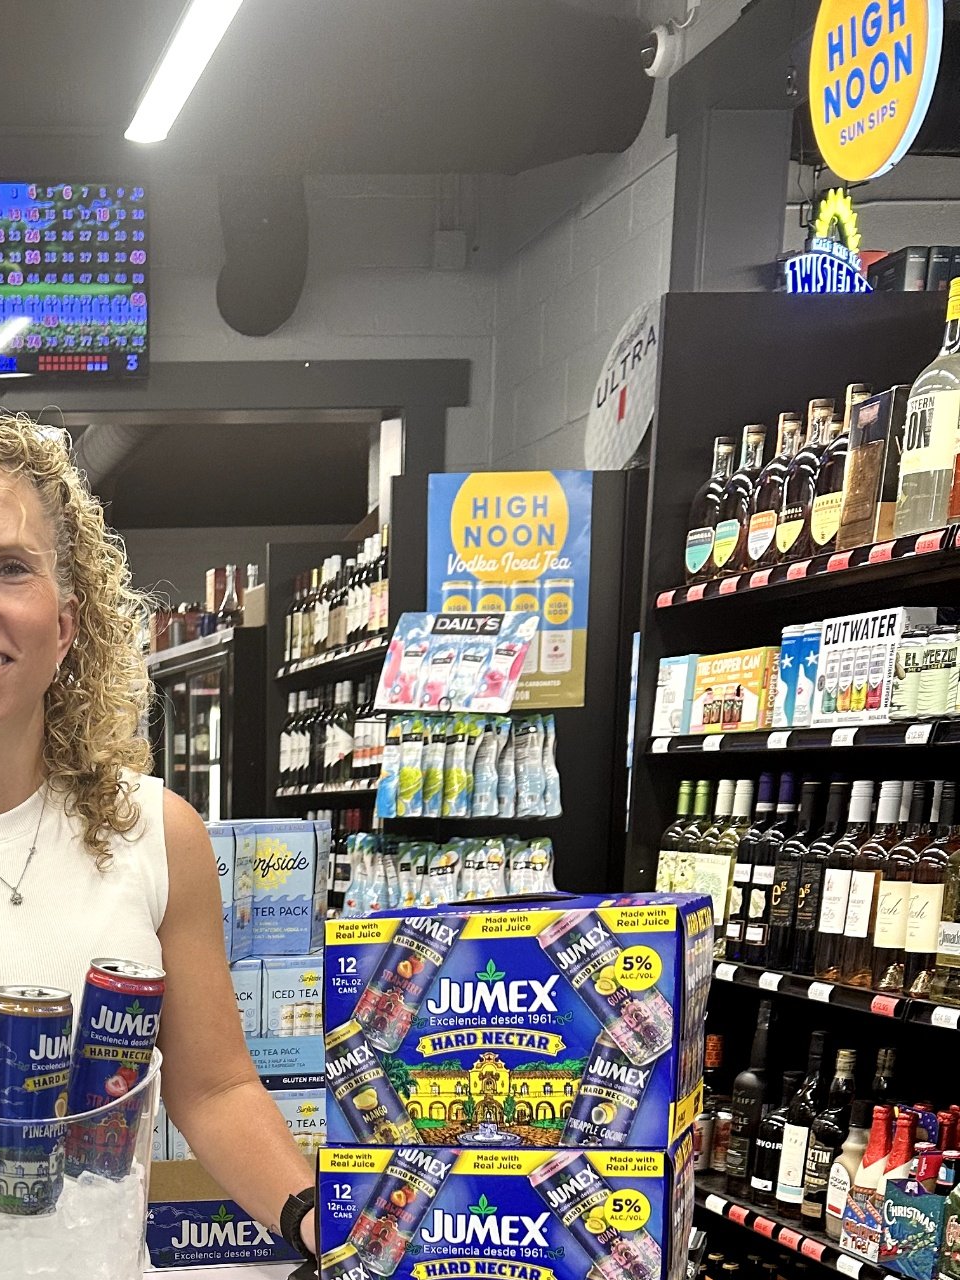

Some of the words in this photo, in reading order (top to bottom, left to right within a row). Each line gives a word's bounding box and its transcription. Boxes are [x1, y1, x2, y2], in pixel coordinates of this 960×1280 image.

[828, 0, 906, 71] HIGH
[824, 34, 913, 124] NOON
[840, 118, 864, 145] SUN
[868, 105, 896, 130] SIPS
[597, 326, 656, 409] ULTRA
[472, 496, 548, 519] HIGH
[464, 524, 555, 547] NOON
[447, 553, 498, 575] Vodka
[500, 552, 540, 572] Iced
[542, 550, 572, 571] Tea
[436, 615, 500, 632] DAILY'S
[824, 614, 896, 645] CUTWATER
[698, 663, 711, 675] THE
[712, 657, 741, 673] COPPER
[743, 653, 763, 670] CAN
[905, 653, 919, 666] EL
[280, 907, 308, 916] PACK
[621, 911, 642, 919] Made
[645, 910, 666, 918] with
[338, 923, 360, 931] Made
[617, 919, 640, 927] Real
[642, 917, 669, 926] Juice
[336, 931, 354, 939] Real
[357, 929, 380, 938] Juice
[338, 957, 356, 973] 12
[622, 955, 652, 971] 5%
[427, 975, 560, 1014] JUMEX
[429, 1015, 487, 1026] Excelencia
[491, 1014, 524, 1025] desde
[91, 1032, 128, 1045] Excelencia
[432, 1033, 480, 1051] HARD
[482, 1032, 550, 1051] NECTAR
[90, 1048, 118, 1057] HARD
[33, 1075, 61, 1088] HARD
[24, 1194, 38, 1203] 5%
[333, 1184, 351, 1200] 12
[612, 1199, 641, 1214] 5%
[333, 1211, 353, 1219] CANS
[884, 1199, 936, 1233] CHRISTMAS
[172, 1220, 275, 1248] JUMEX
[420, 1209, 550, 1246] JUMEX
[175, 1252, 221, 1260] Excelencia
[224, 1249, 250, 1258] desde
[424, 1244, 479, 1257] Excelencia
[483, 1246, 517, 1257] desde
[424, 1261, 470, 1278] HARD
